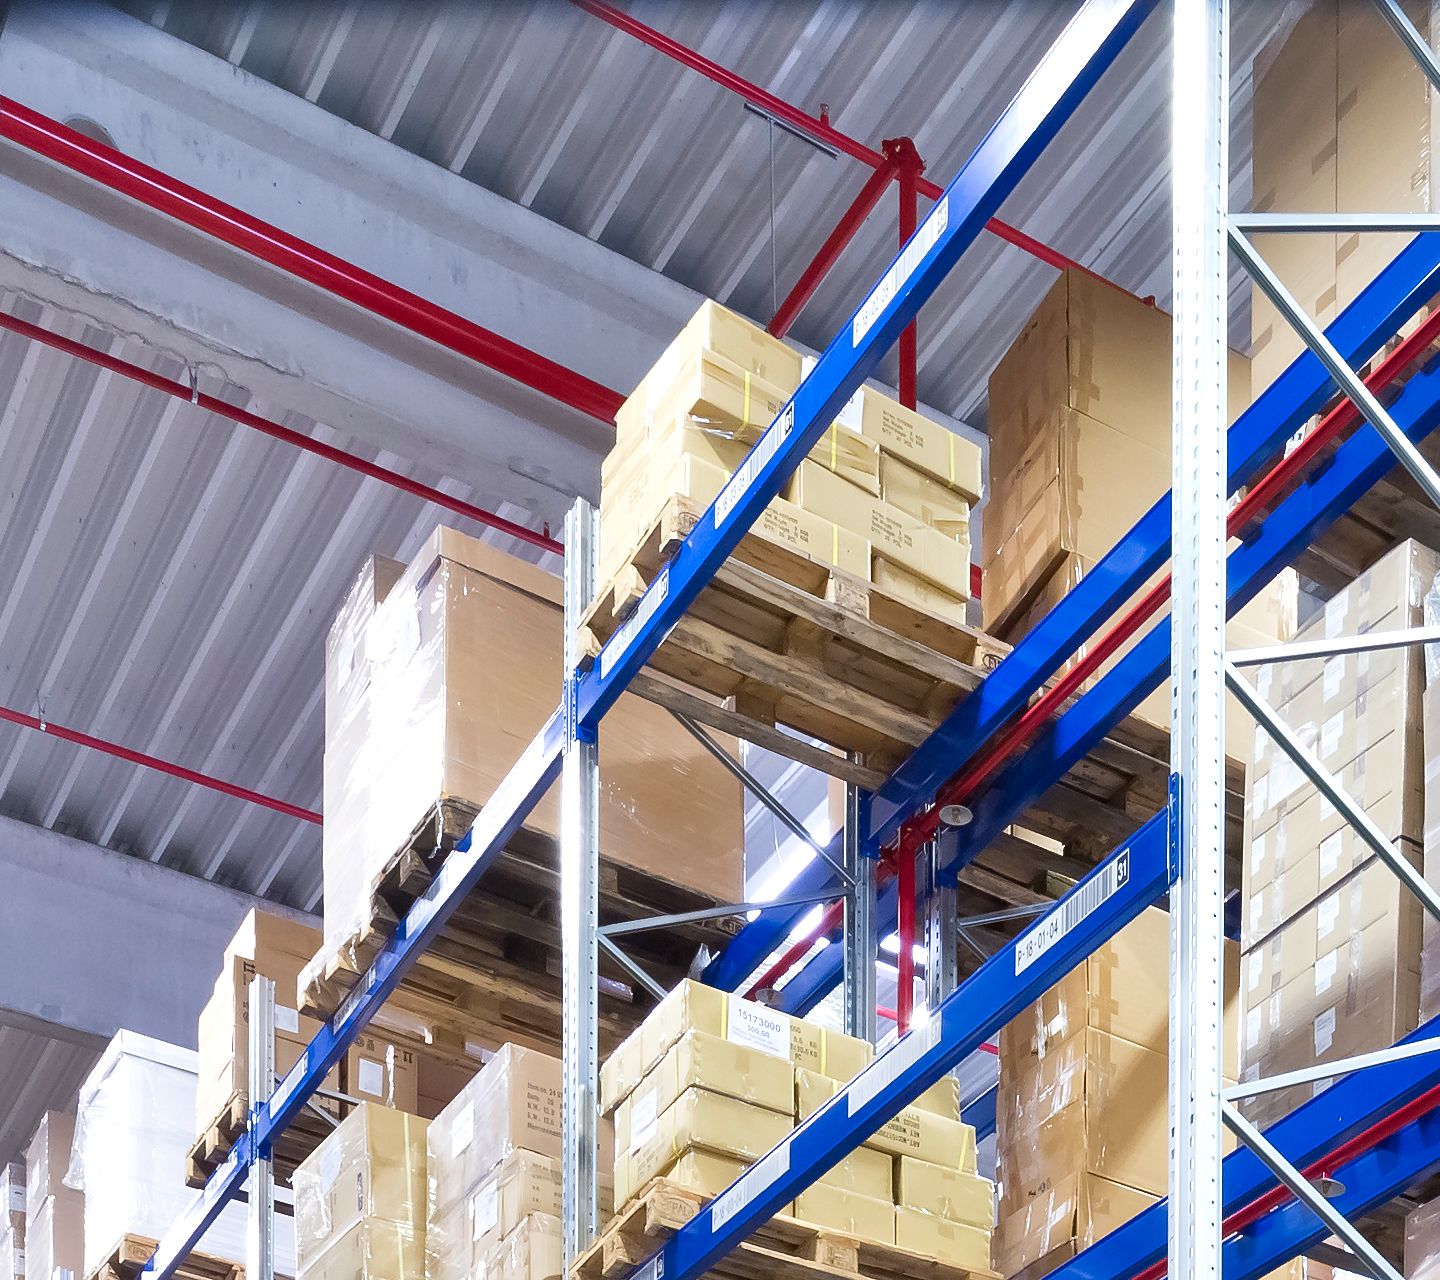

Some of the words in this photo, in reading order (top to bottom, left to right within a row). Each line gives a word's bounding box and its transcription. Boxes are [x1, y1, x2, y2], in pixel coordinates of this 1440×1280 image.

[1016, 917, 1059, 967] P-18-01-04
[1117, 859, 1127, 880] 31
[738, 1008, 781, 1033] 15173000
